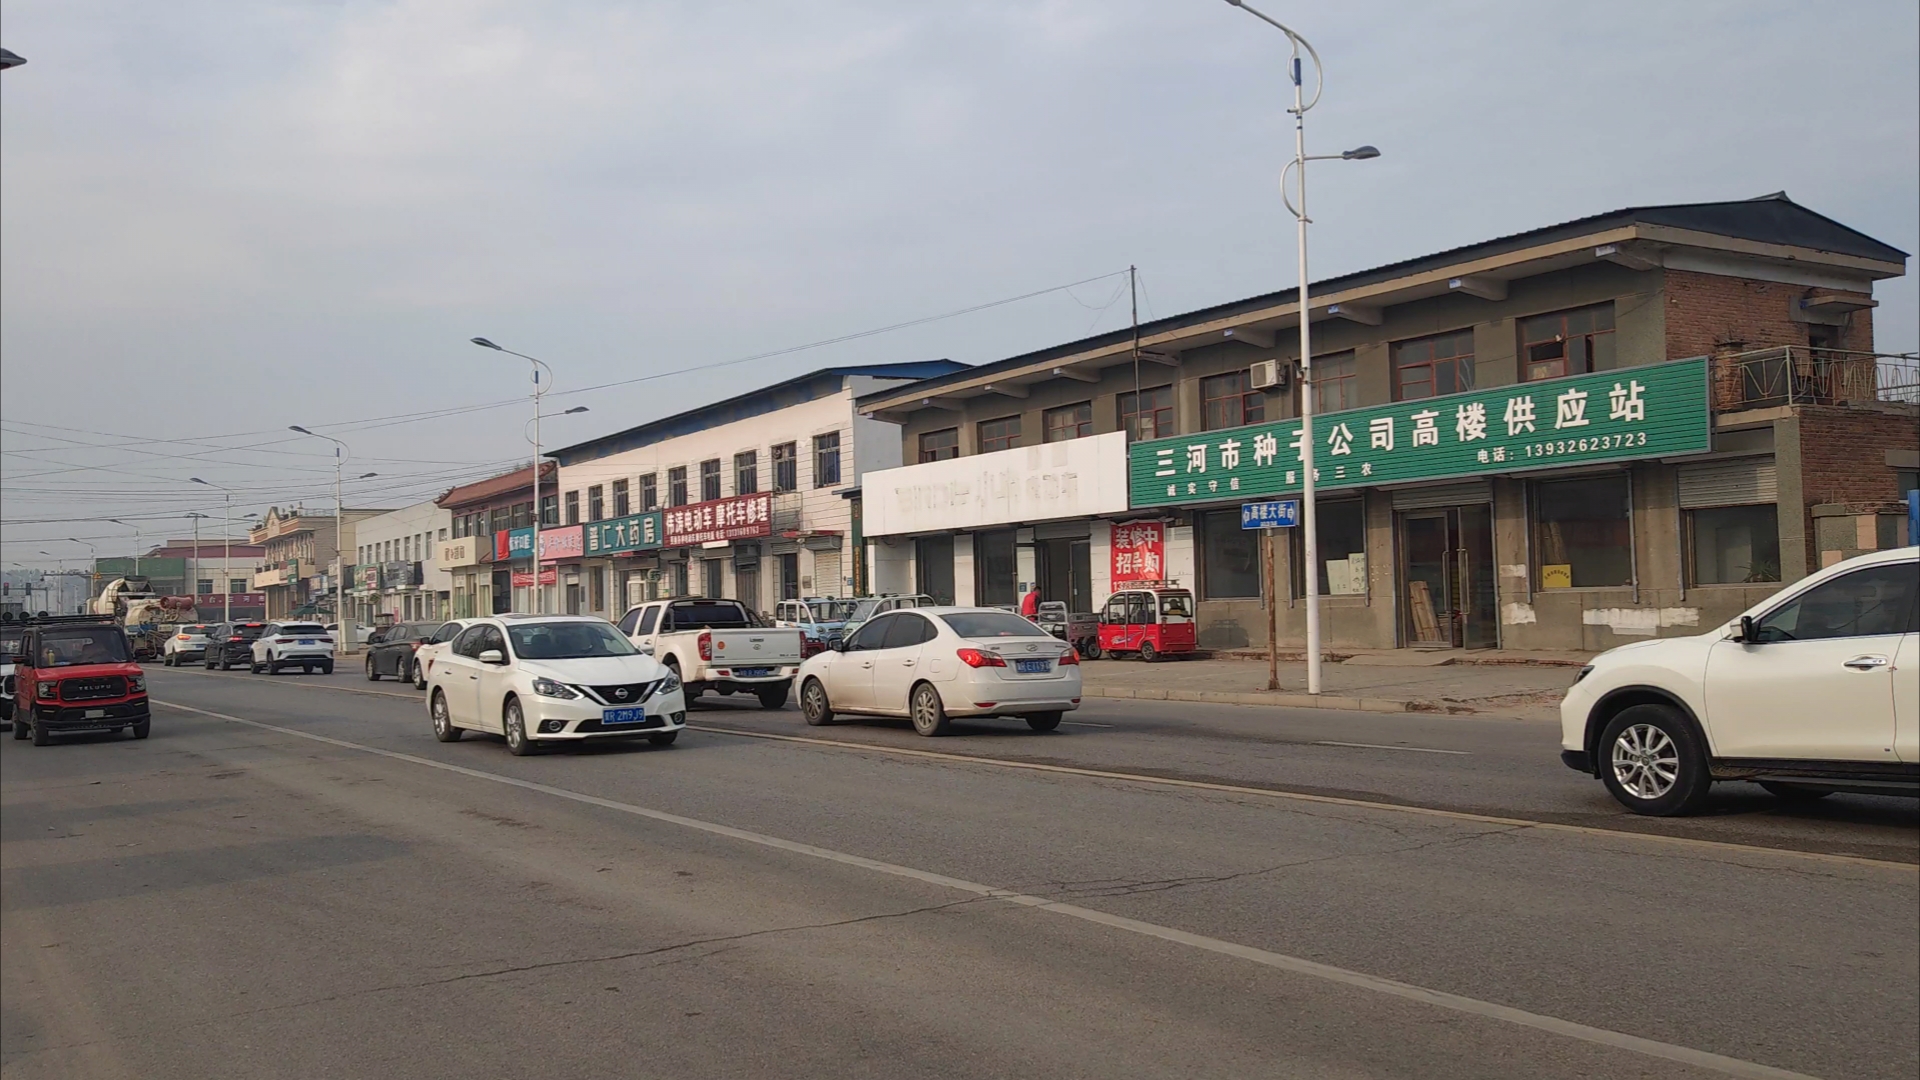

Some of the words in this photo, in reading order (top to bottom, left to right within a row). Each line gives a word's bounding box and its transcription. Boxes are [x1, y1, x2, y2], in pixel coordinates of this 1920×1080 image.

[1155, 380, 1646, 477] 三河市种子公司高楼供应站
[1525, 432, 1647, 457] 13932623723
[1167, 477, 1240, 497] 诚实守信
[716, 497, 768, 528] 摩托车修理
[1251, 503, 1286, 520] 高楼大街
[1116, 526, 1158, 549] 装修中
[1116, 551, 1160, 574] 招导购
